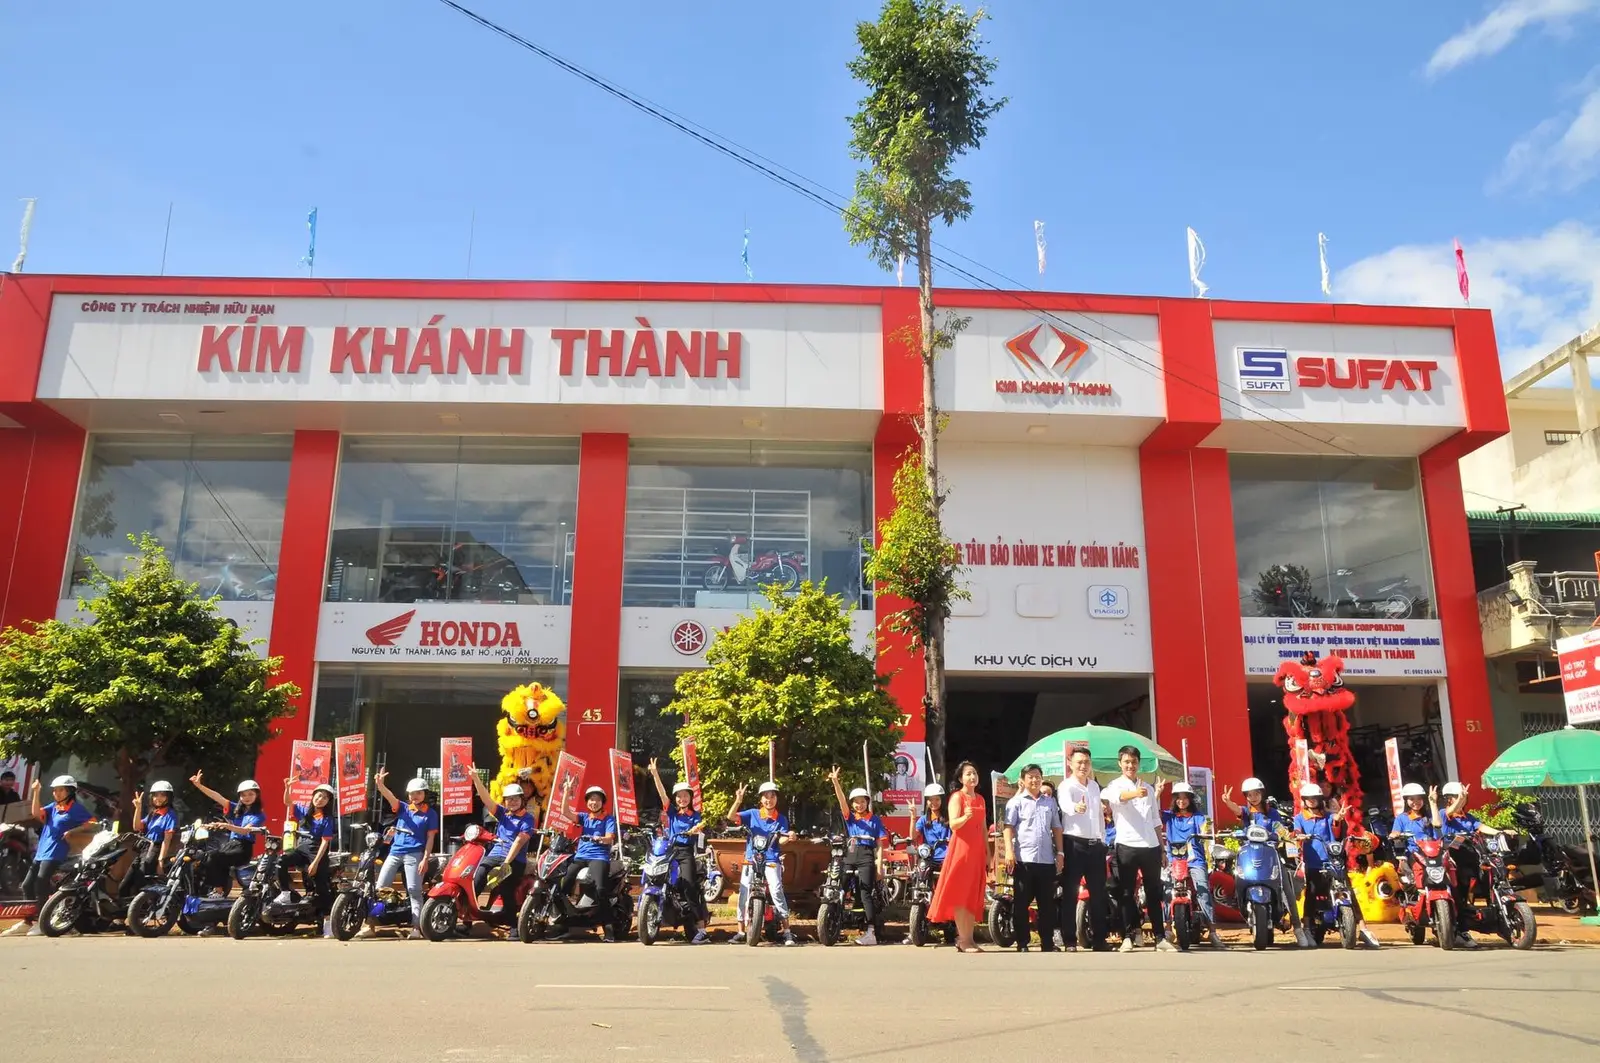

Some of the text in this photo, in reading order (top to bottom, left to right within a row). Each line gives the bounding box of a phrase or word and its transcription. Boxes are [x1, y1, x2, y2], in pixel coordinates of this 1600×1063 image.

[81, 300, 116, 312] CÔNG
[121, 302, 136, 312] TY
[142, 301, 180, 313] TRÁCH
[184, 301, 220, 316] NHIỆM
[251, 304, 275, 316] HẠN
[329, 314, 525, 374] KHÁNH
[551, 316, 742, 378] THÀNH
[1296, 357, 1438, 391] SUFAT
[1246, 381, 1285, 390] SUFAT
[965, 538, 986, 565] TÂM
[990, 536, 1010, 566] BẢO
[1012, 539, 1039, 566] HÀNH
[1041, 544, 1055, 567] XE
[1057, 540, 1076, 567] MÁY
[1080, 541, 1109, 568] CHÍNH
[1112, 542, 1140, 568] HÃNG
[419, 621, 522, 647] HONDA
[1297, 623, 1405, 632] SUFAT VIETNAM CORPORATION
[1344, 637, 1365, 645] SUFAT
[1383, 638, 1399, 646] NAM
[1278, 650, 1320, 658] SHOWRM
[1349, 647, 1382, 659] KHÁNH
[1384, 647, 1415, 660] THÀNH
[974, 654, 1097, 669] KHU VỰC DỊCH VỤ
[582, 708, 603, 721] 45
[1465, 720, 1482, 732] 51
